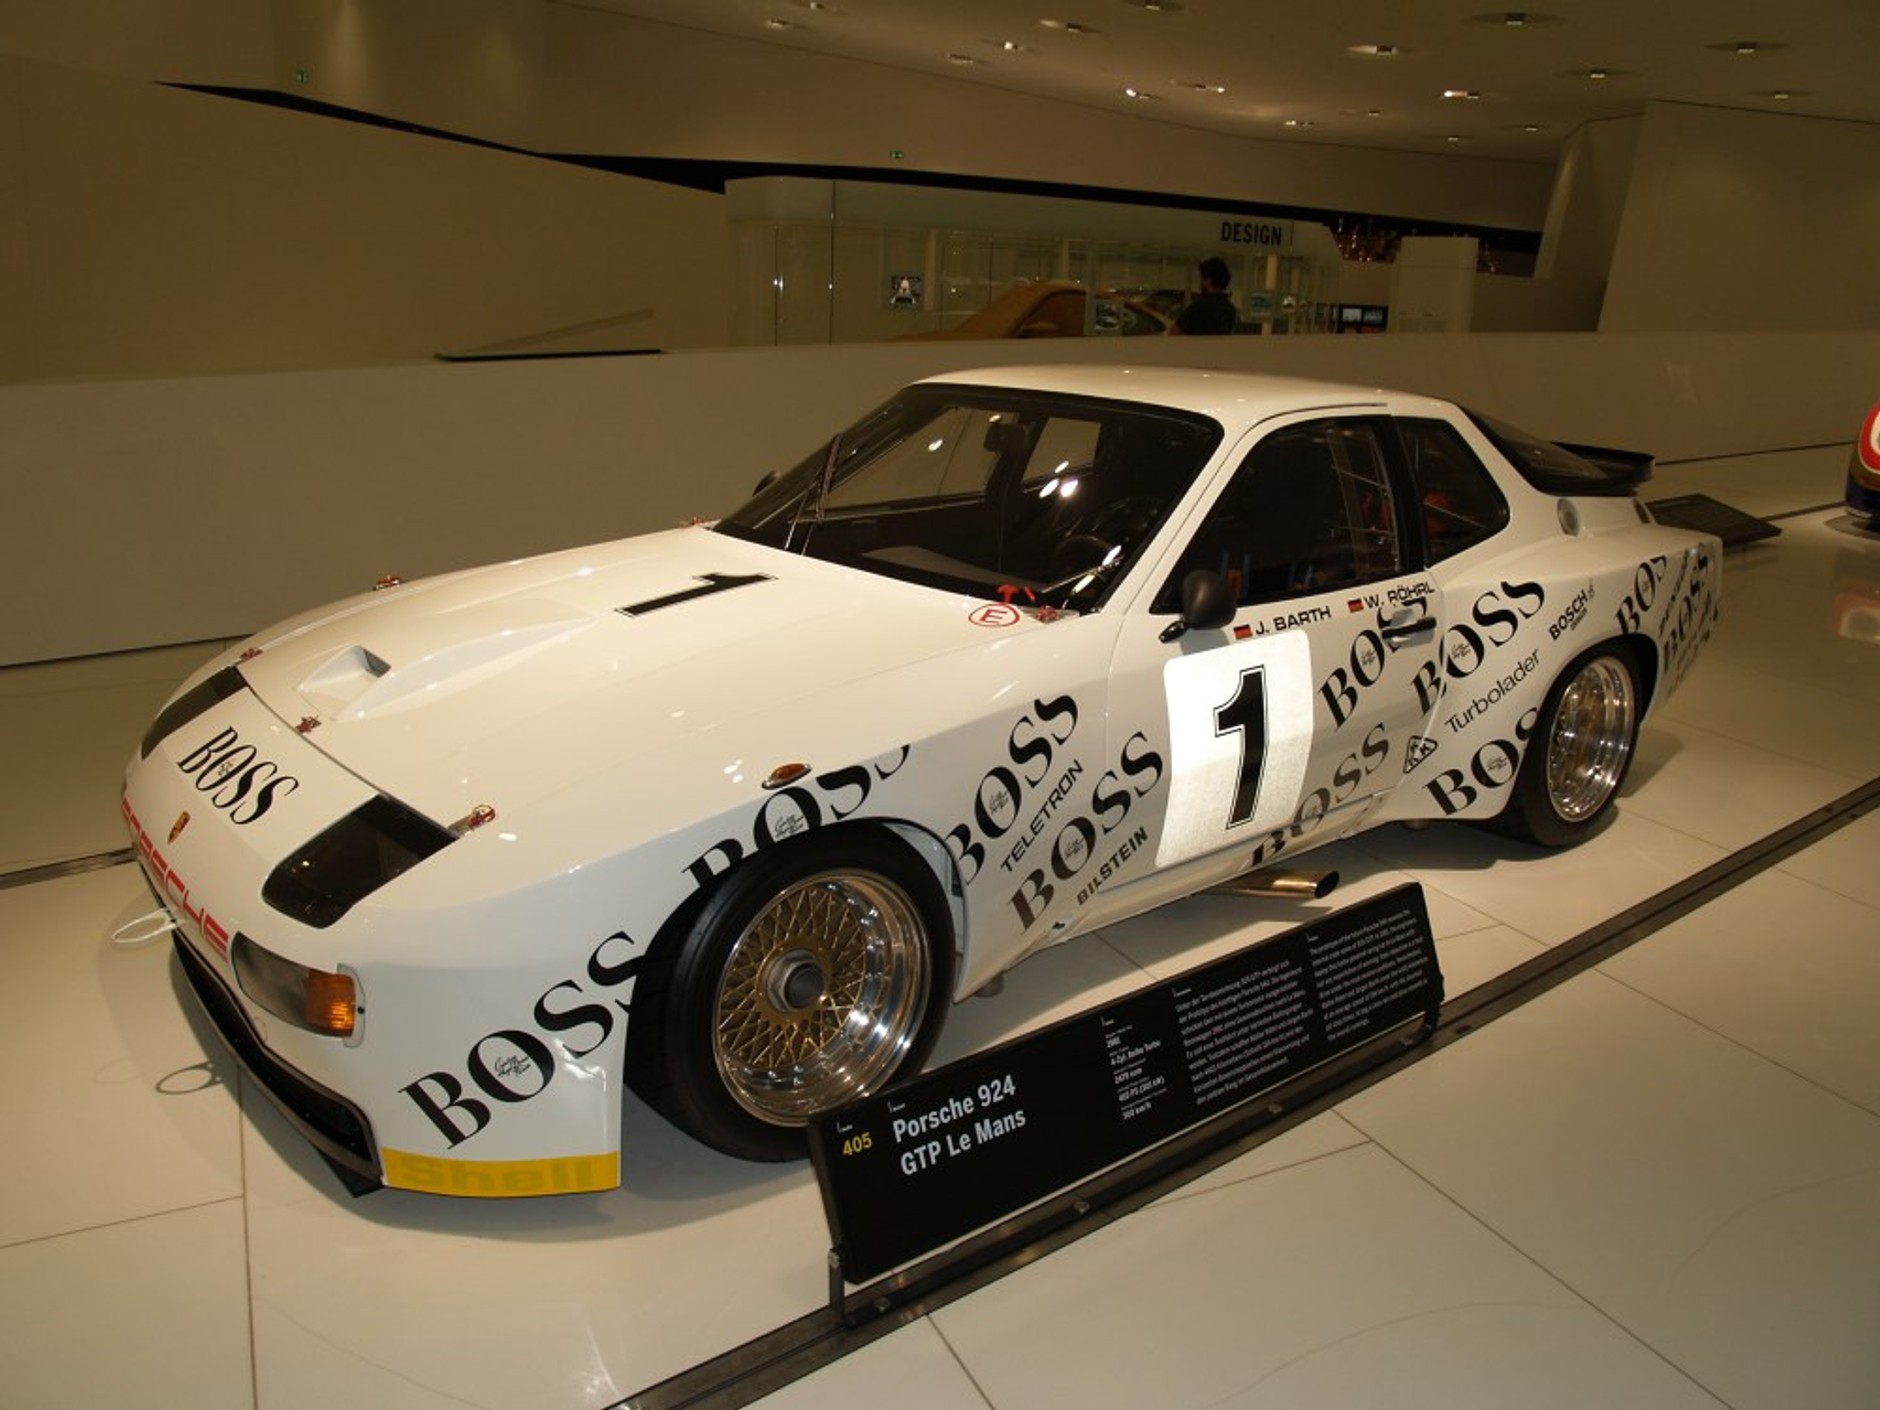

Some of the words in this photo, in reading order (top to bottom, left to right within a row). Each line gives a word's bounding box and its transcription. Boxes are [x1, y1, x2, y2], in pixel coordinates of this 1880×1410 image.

[1221, 221, 1282, 247] DESIGN
[1255, 621, 1272, 635] J.
[1275, 606, 1332, 631] BARTH
[1363, 594, 1385, 609] W.
[1387, 581, 1435, 605] RÖHRL
[1549, 589, 1588, 640] BOSCH
[1411, 580, 1544, 719] BOSS
[1444, 647, 1544, 733] Turbolader
[177, 726, 299, 825] BOSS
[1213, 664, 1269, 830] 1
[1000, 758, 1084, 872] TELETRON
[1006, 731, 1164, 935] BOSS
[1250, 722, 1391, 867] BOSS
[122, 796, 229, 963] PORSCHE
[1076, 825, 1149, 907] BILSTEIN
[398, 930, 645, 1150] BOSS
[842, 1131, 873, 1157] 405
[892, 1093, 974, 1143] Porsche
[977, 1073, 1016, 1108] 924
[900, 1141, 943, 1177] GTP
[948, 1133, 972, 1158] Le
[976, 1107, 1026, 1144] Mans
[400, 1155, 593, 1191] Shell
